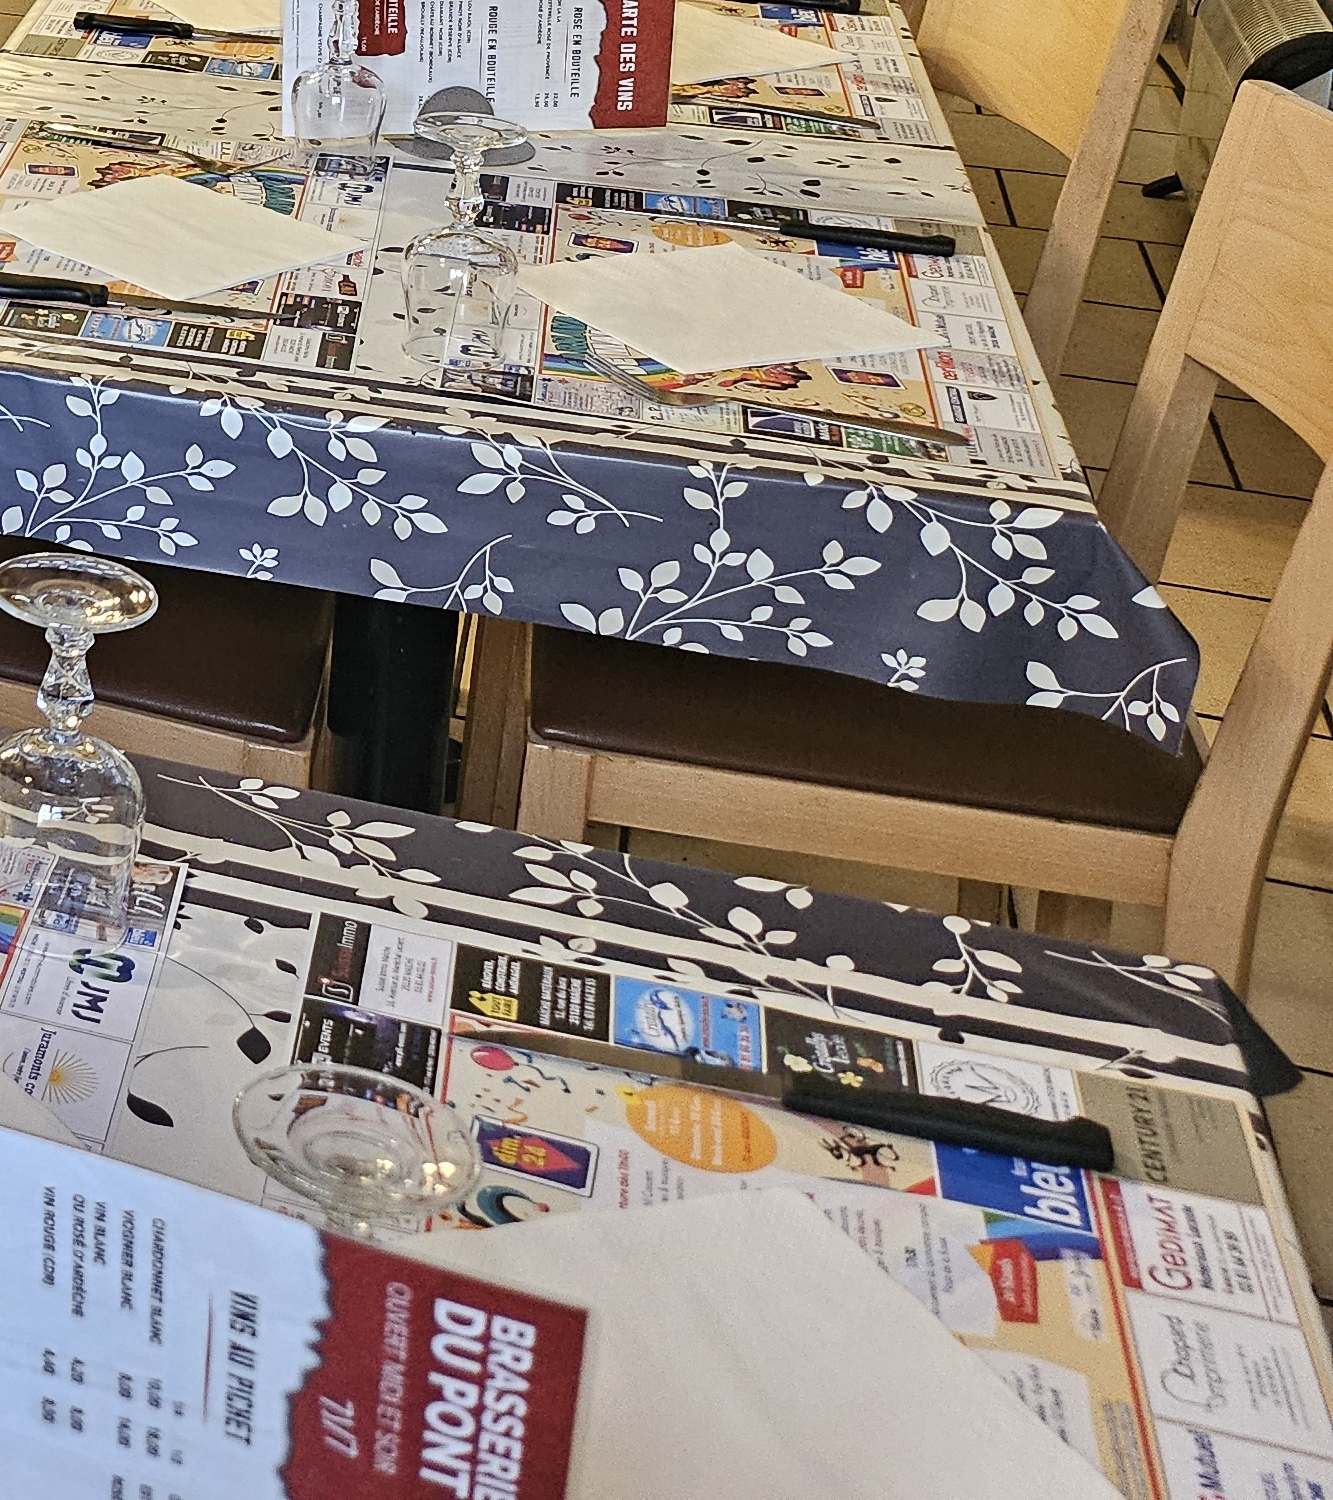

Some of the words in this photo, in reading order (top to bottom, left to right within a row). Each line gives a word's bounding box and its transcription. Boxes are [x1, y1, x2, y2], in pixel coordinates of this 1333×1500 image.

[486, 5, 498, 34] ROUGE
[572, 6, 583, 29] ROSE
[486, 38, 497, 50] EN
[571, 34, 582, 45] EN
[618, 43, 635, 72] DES
[484, 54, 497, 102] BOUTEILLE
[569, 49, 581, 97] BOUTEILLE
[616, 78, 634, 111] VINS
[71, 980, 111, 1025] JMJ
[490, 995, 500, 1014] TOUT
[501, 997, 512, 1016] FAIRE
[32, 1027, 58, 1081] Juramonts
[317, 1017, 333, 1053] EVENTS
[1132, 1087, 1150, 1104] 21
[1134, 1108, 1169, 1184] CENTURY
[42, 1184, 54, 1209] VIN
[71, 1192, 84, 1215] OU
[94, 1200, 106, 1223] VIN
[42, 1209, 55, 1252] ROUGE
[71, 1214, 85, 1249] ROSÉ
[94, 1223, 106, 1267] BLANC
[120, 1209, 133, 1269] VIOGNIER
[150, 1216, 163, 1304] CHARDONNET
[120, 1268, 132, 1312] BLANC
[150, 1304, 162, 1346] BLANC
[227, 1290, 259, 1336] VINS
[383, 1281, 413, 1361] OUVERT
[225, 1339, 257, 1370] AU
[429, 1297, 487, 1374] DU
[379, 1360, 406, 1402] MIDI
[222, 1373, 255, 1446] PICHET
[376, 1403, 403, 1432] ET
[373, 1429, 401, 1476] SOIR
[418, 1371, 481, 1499] PONT
